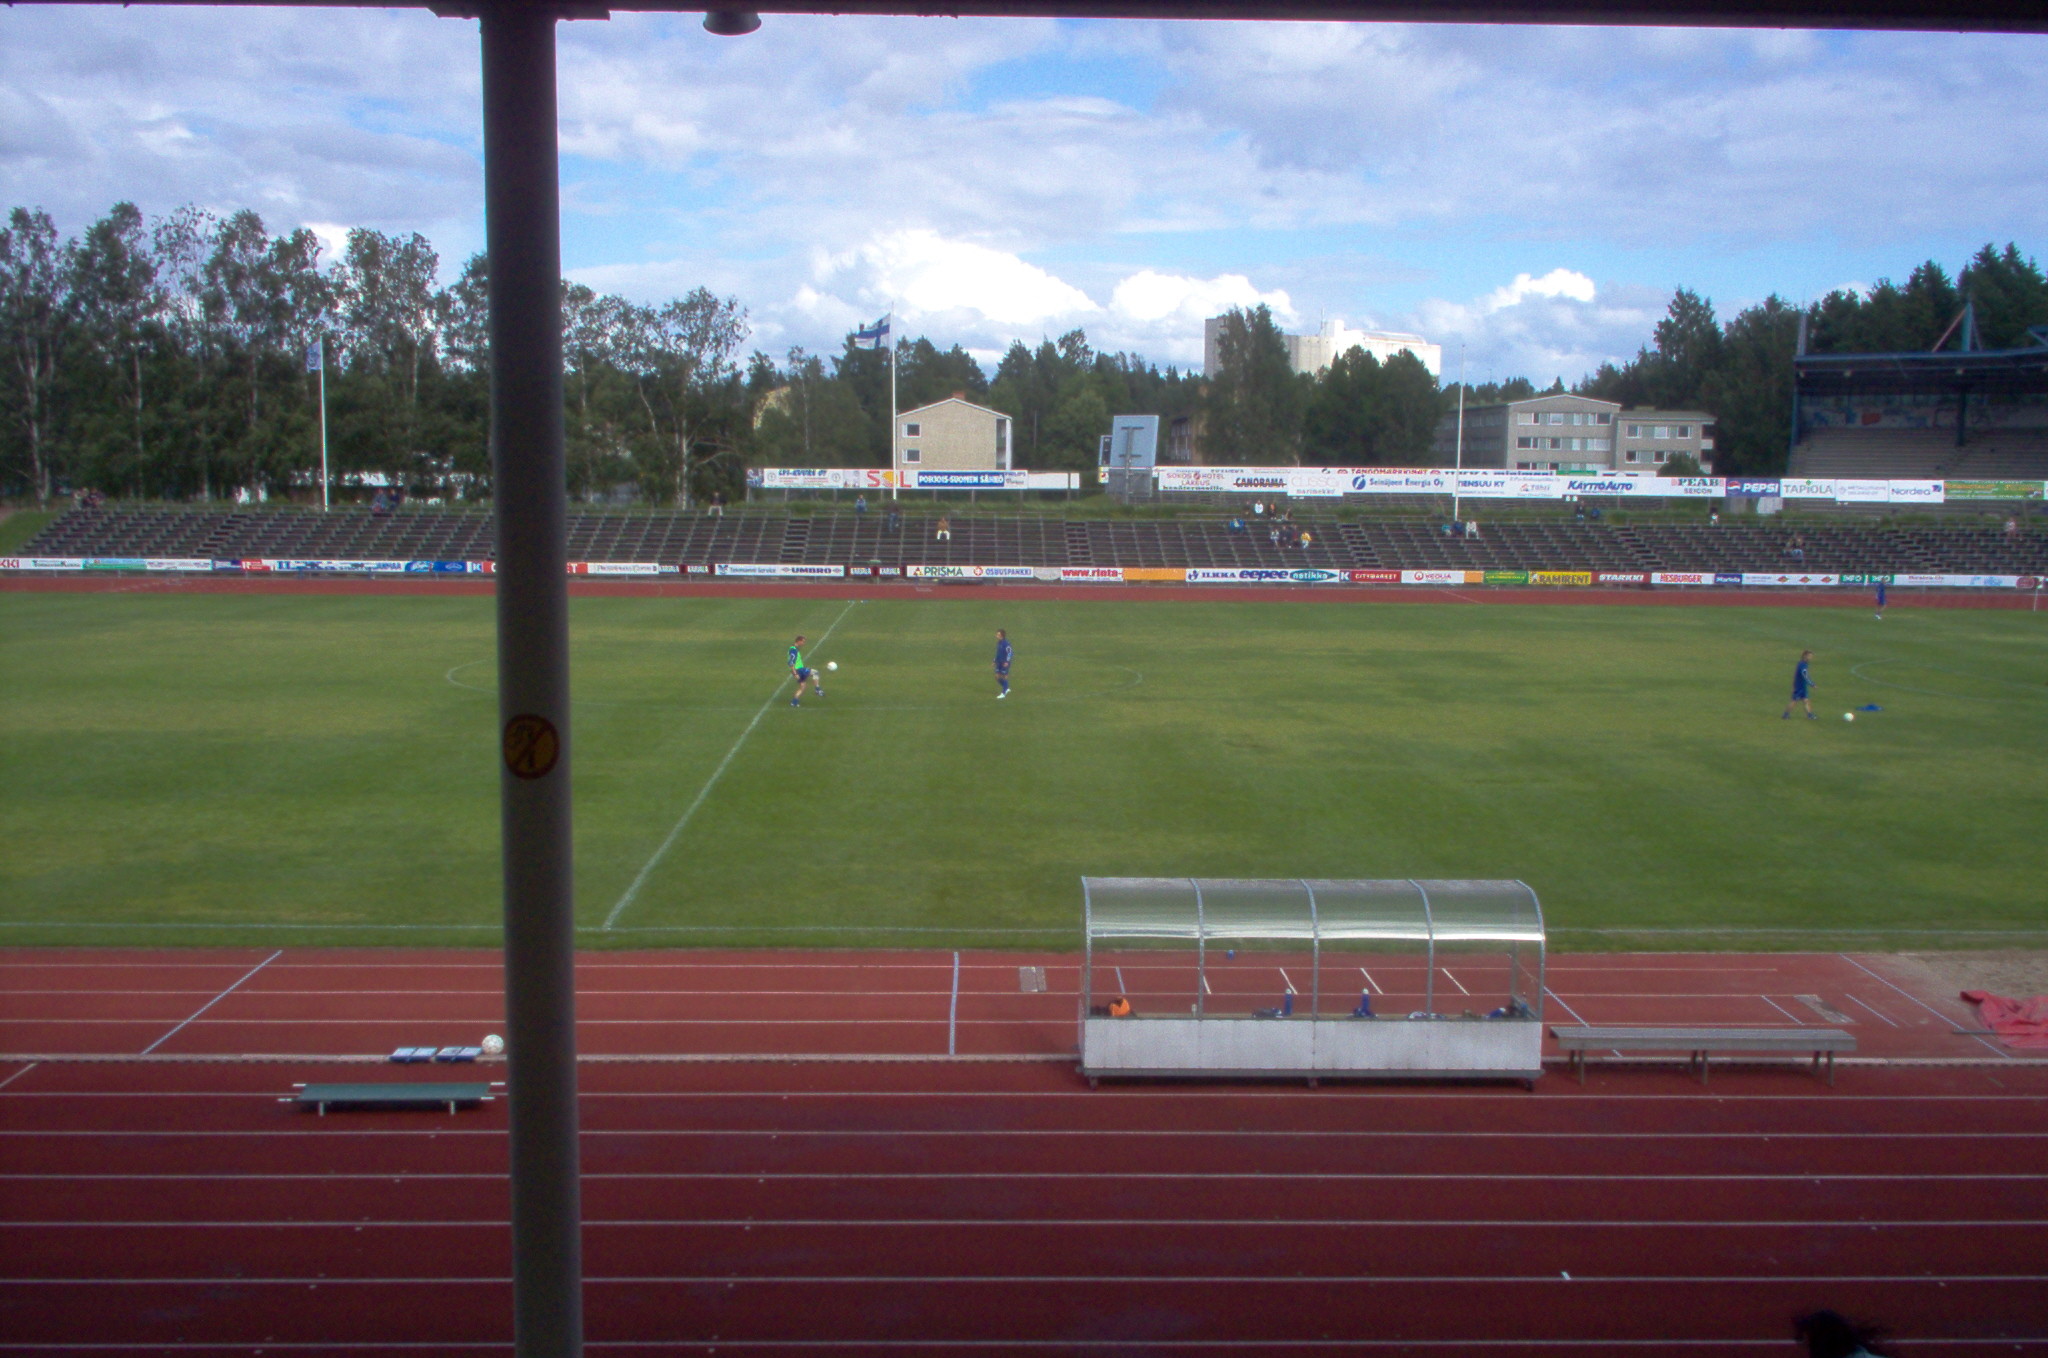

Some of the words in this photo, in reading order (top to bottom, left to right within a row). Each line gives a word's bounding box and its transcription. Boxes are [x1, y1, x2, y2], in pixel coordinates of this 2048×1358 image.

[1369, 478, 1403, 488] Seinäjoen
[1405, 478, 1431, 488] Energia
[1433, 479, 1444, 488] Oy
[1493, 480, 1506, 488] KY
[1678, 478, 1720, 487] PEAB
[1742, 483, 1779, 493] PEPSI
[1783, 485, 1833, 494] TAPIOLA
[1891, 487, 1931, 496] Nordea
[924, 566, 964, 577] PRISMA
[1239, 570, 1289, 581] eepee
[1340, 571, 1350, 580] K
[1538, 574, 1591, 585] RAMIRENT
[1598, 574, 1644, 582] STARKKI
[1660, 573, 1702, 584] HESBURGER
